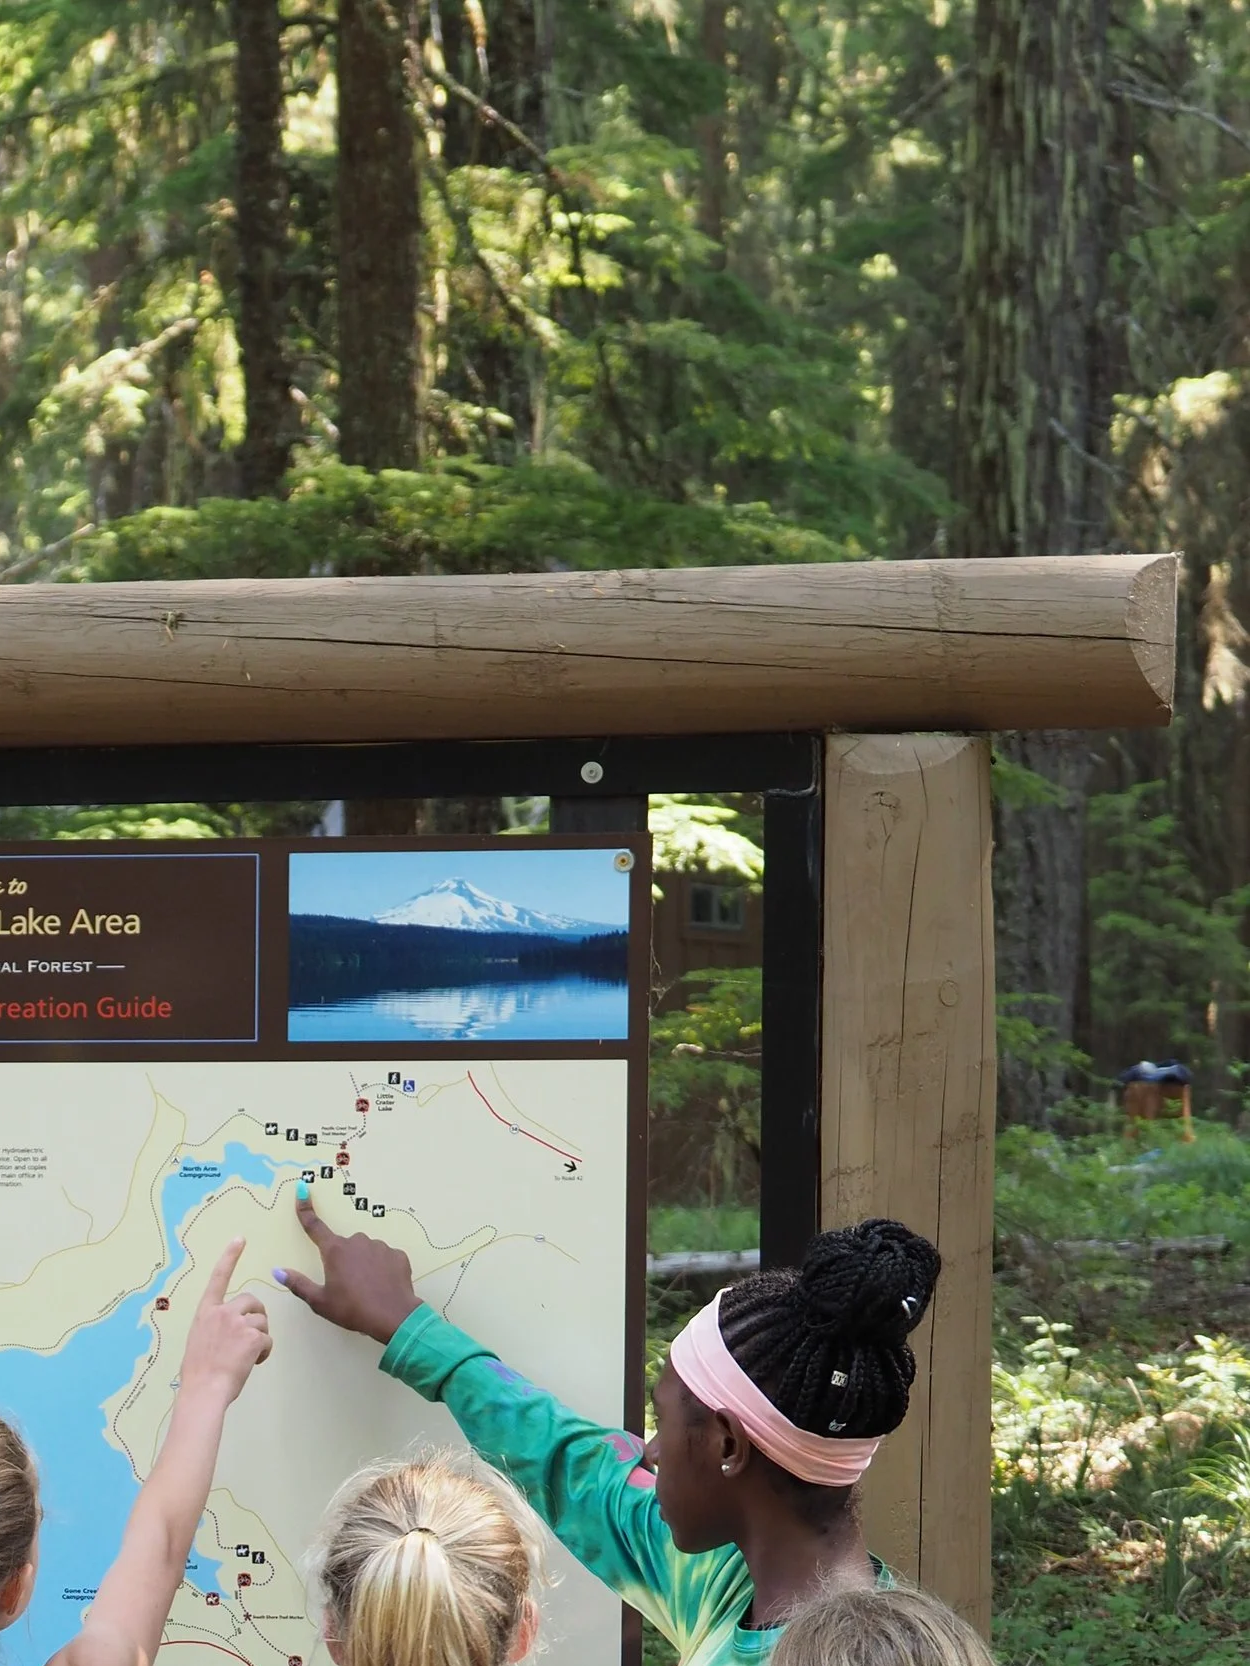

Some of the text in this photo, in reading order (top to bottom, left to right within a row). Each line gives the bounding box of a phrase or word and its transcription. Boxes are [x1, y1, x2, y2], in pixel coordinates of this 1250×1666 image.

[8, 878, 28, 895] to
[68, 908, 142, 936] Area
[96, 995, 173, 1019] Guide
